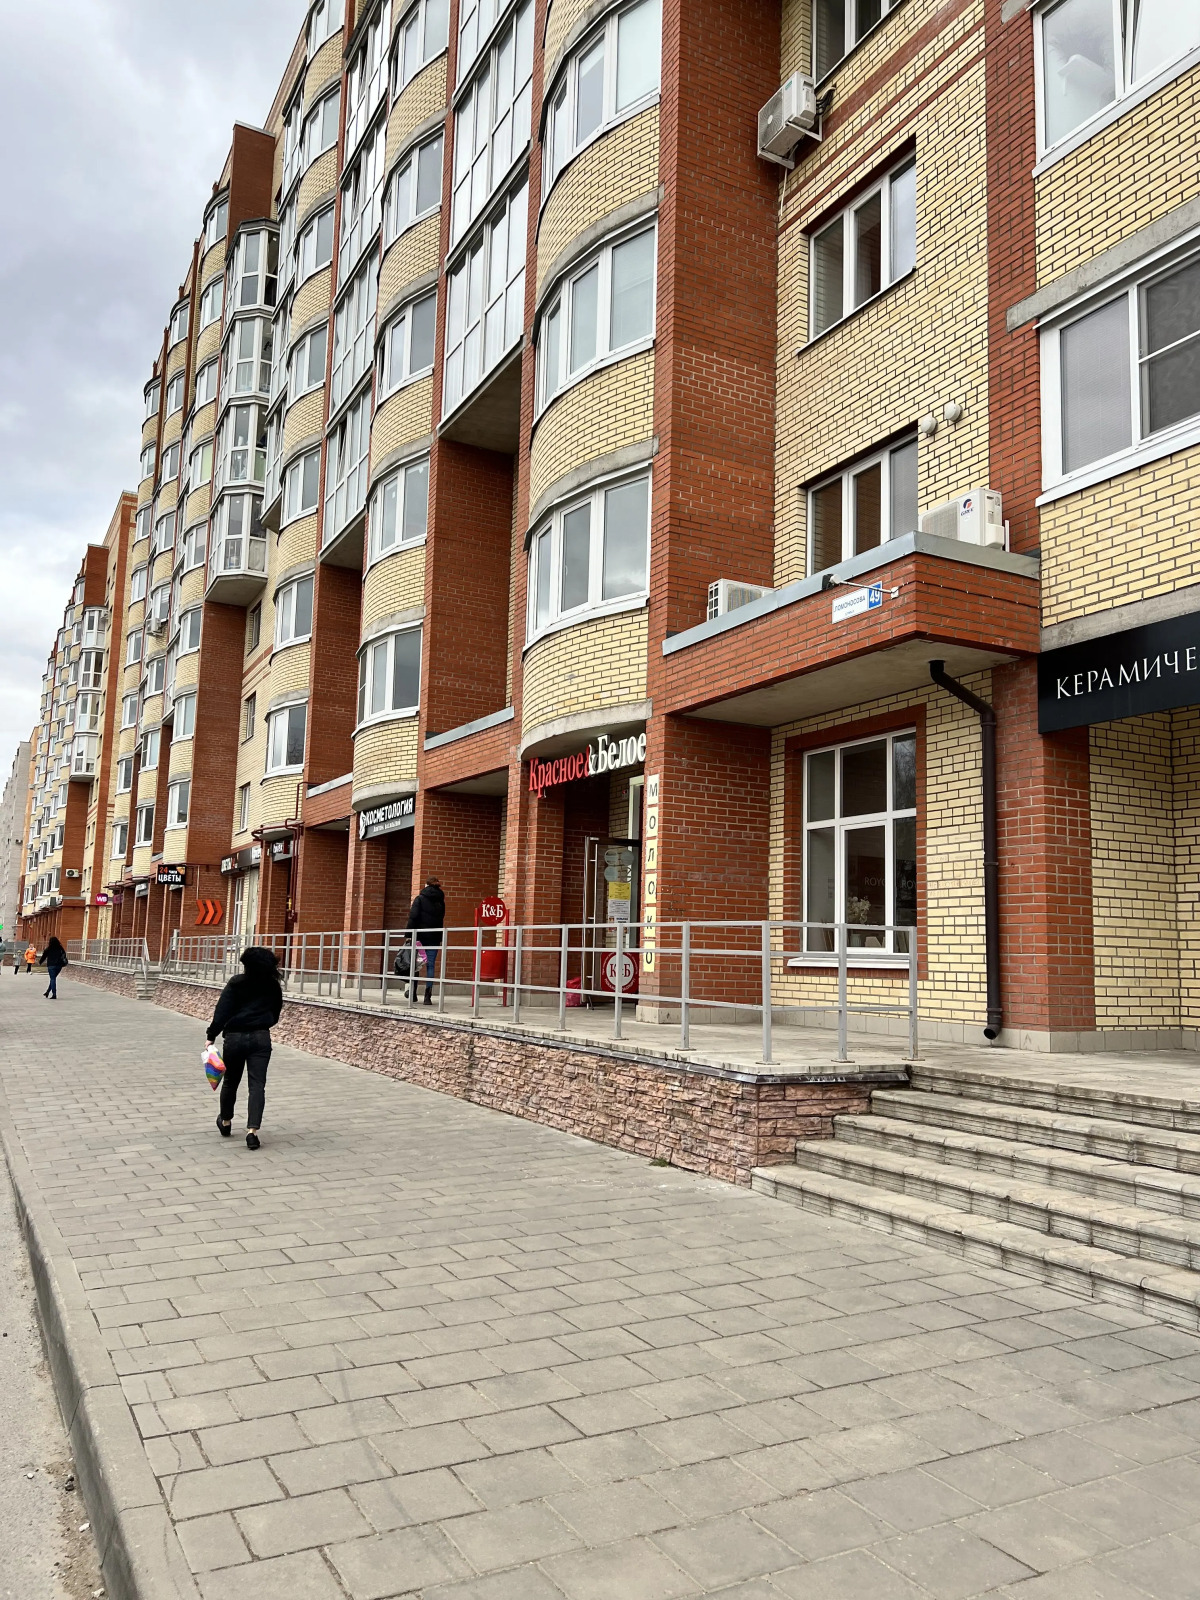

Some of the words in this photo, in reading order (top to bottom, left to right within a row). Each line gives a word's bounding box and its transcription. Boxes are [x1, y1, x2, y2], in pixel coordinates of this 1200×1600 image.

[833, 595, 866, 612] ЛОМОНОСОВА
[870, 589, 880, 603] 49
[1056, 646, 1198, 699] КЕРАМИЧЕ
[365, 797, 413, 826] КОСМЕТОЛОГИЯ
[159, 866, 168, 874] 24
[158, 874, 182, 883] ЦВЕТЫ
[481, 903, 504, 918] К&Б
[609, 963, 631, 978] КБ
